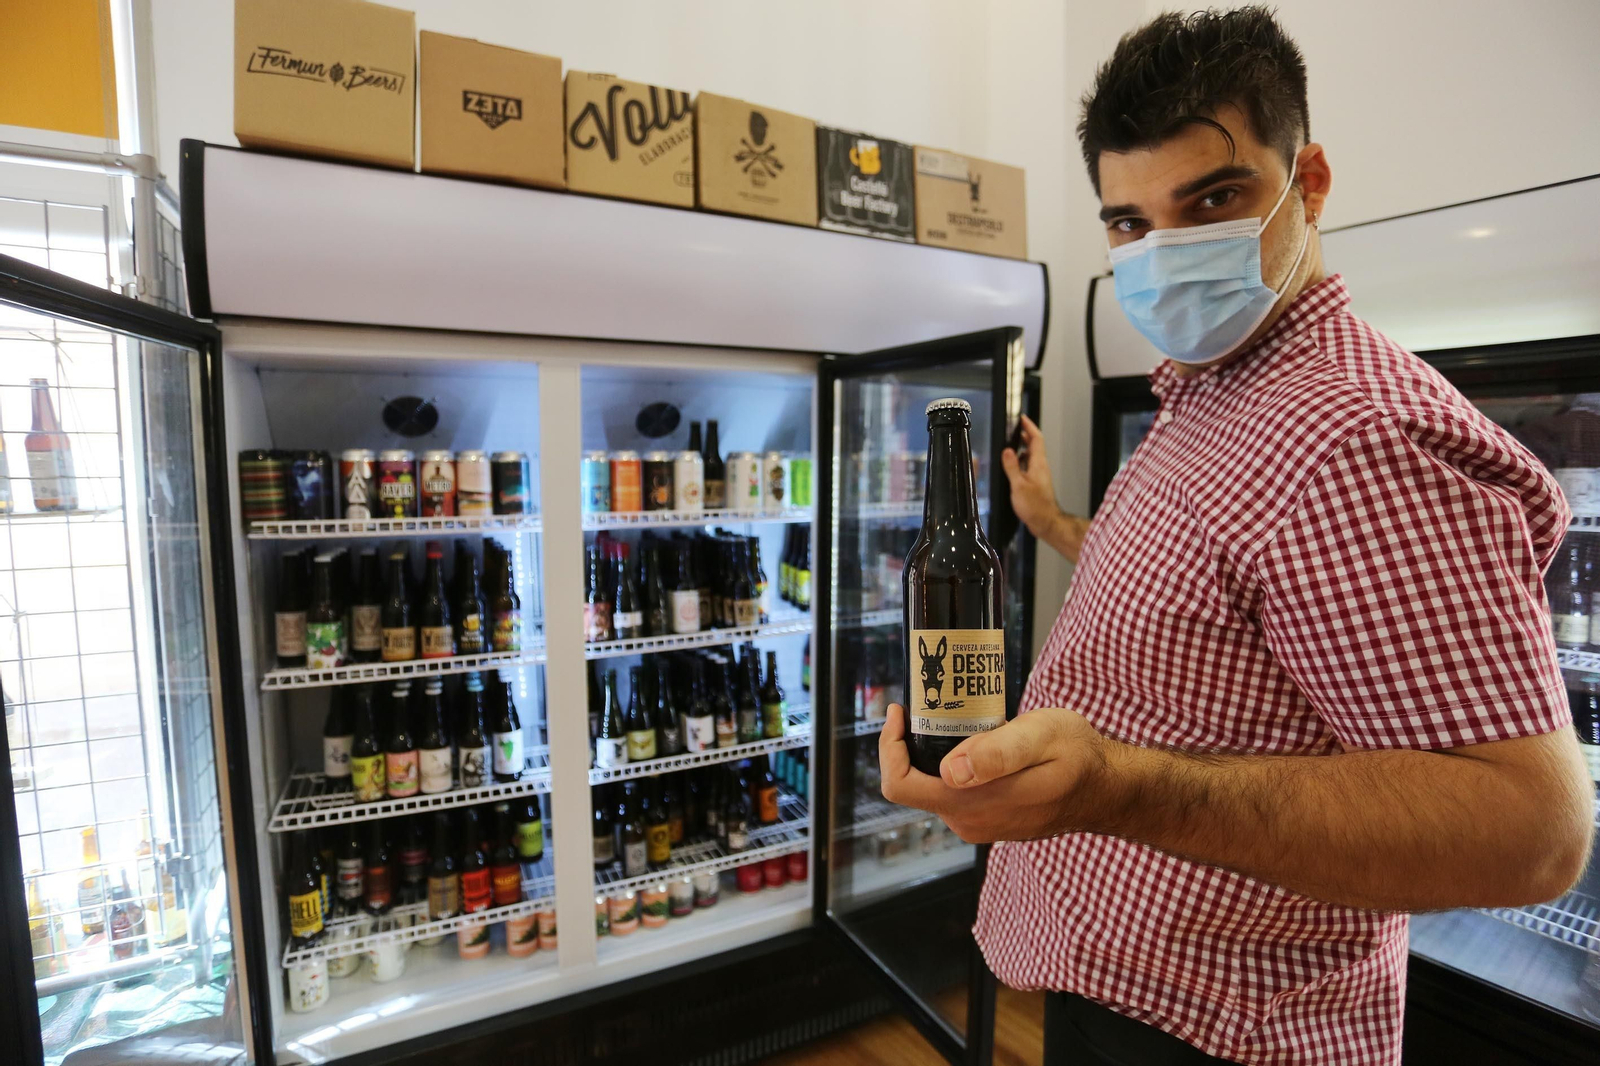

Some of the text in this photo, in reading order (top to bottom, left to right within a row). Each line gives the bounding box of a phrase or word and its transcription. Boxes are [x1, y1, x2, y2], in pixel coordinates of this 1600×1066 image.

[257, 46, 399, 92] Fermun Beers
[952, 643, 978, 652] CERVEZA
[952, 653, 1004, 674] DESTRA
[962, 723, 978, 732] India
[291, 899, 317, 919] HELL
